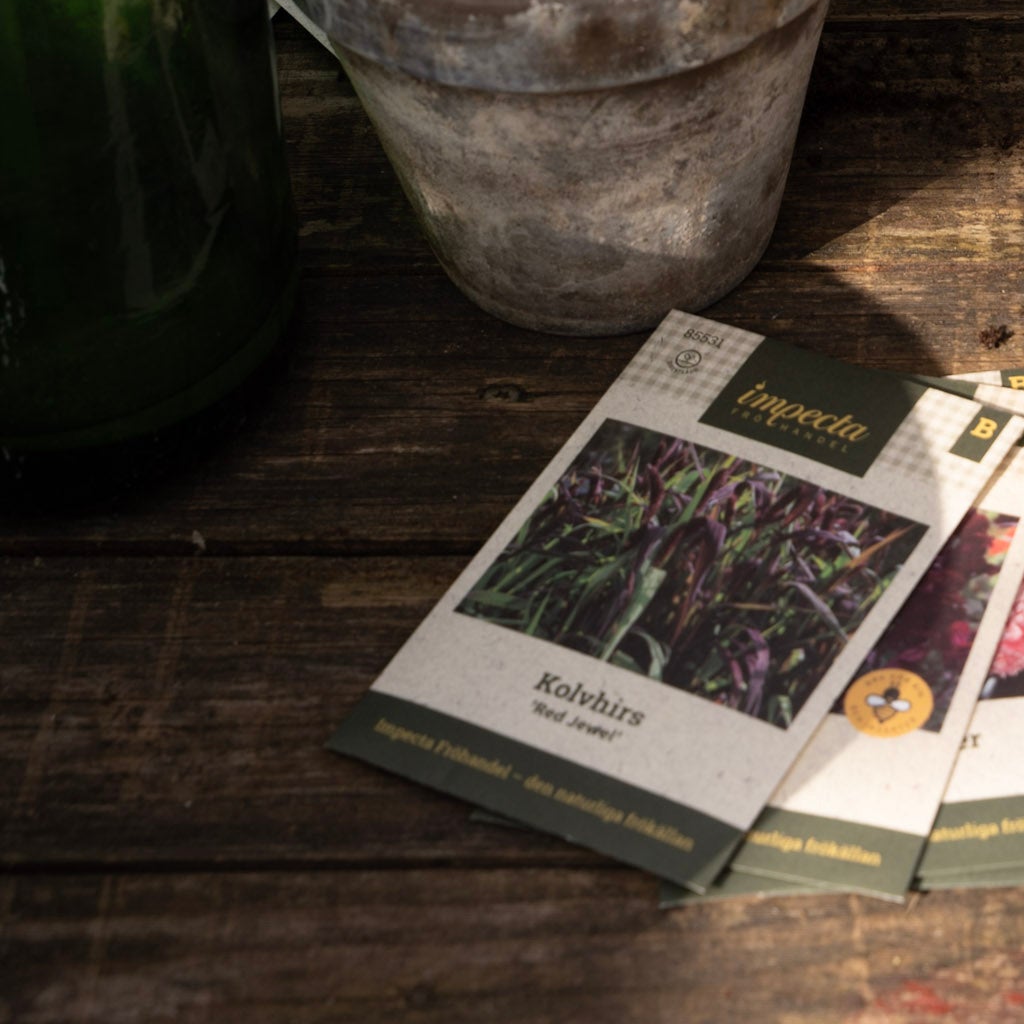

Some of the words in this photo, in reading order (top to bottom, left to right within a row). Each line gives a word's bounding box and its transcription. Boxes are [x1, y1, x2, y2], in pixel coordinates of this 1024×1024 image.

[737, 380, 870, 442] impecta
[970, 416, 998, 439] B
[533, 672, 645, 727] Kolvhirs
